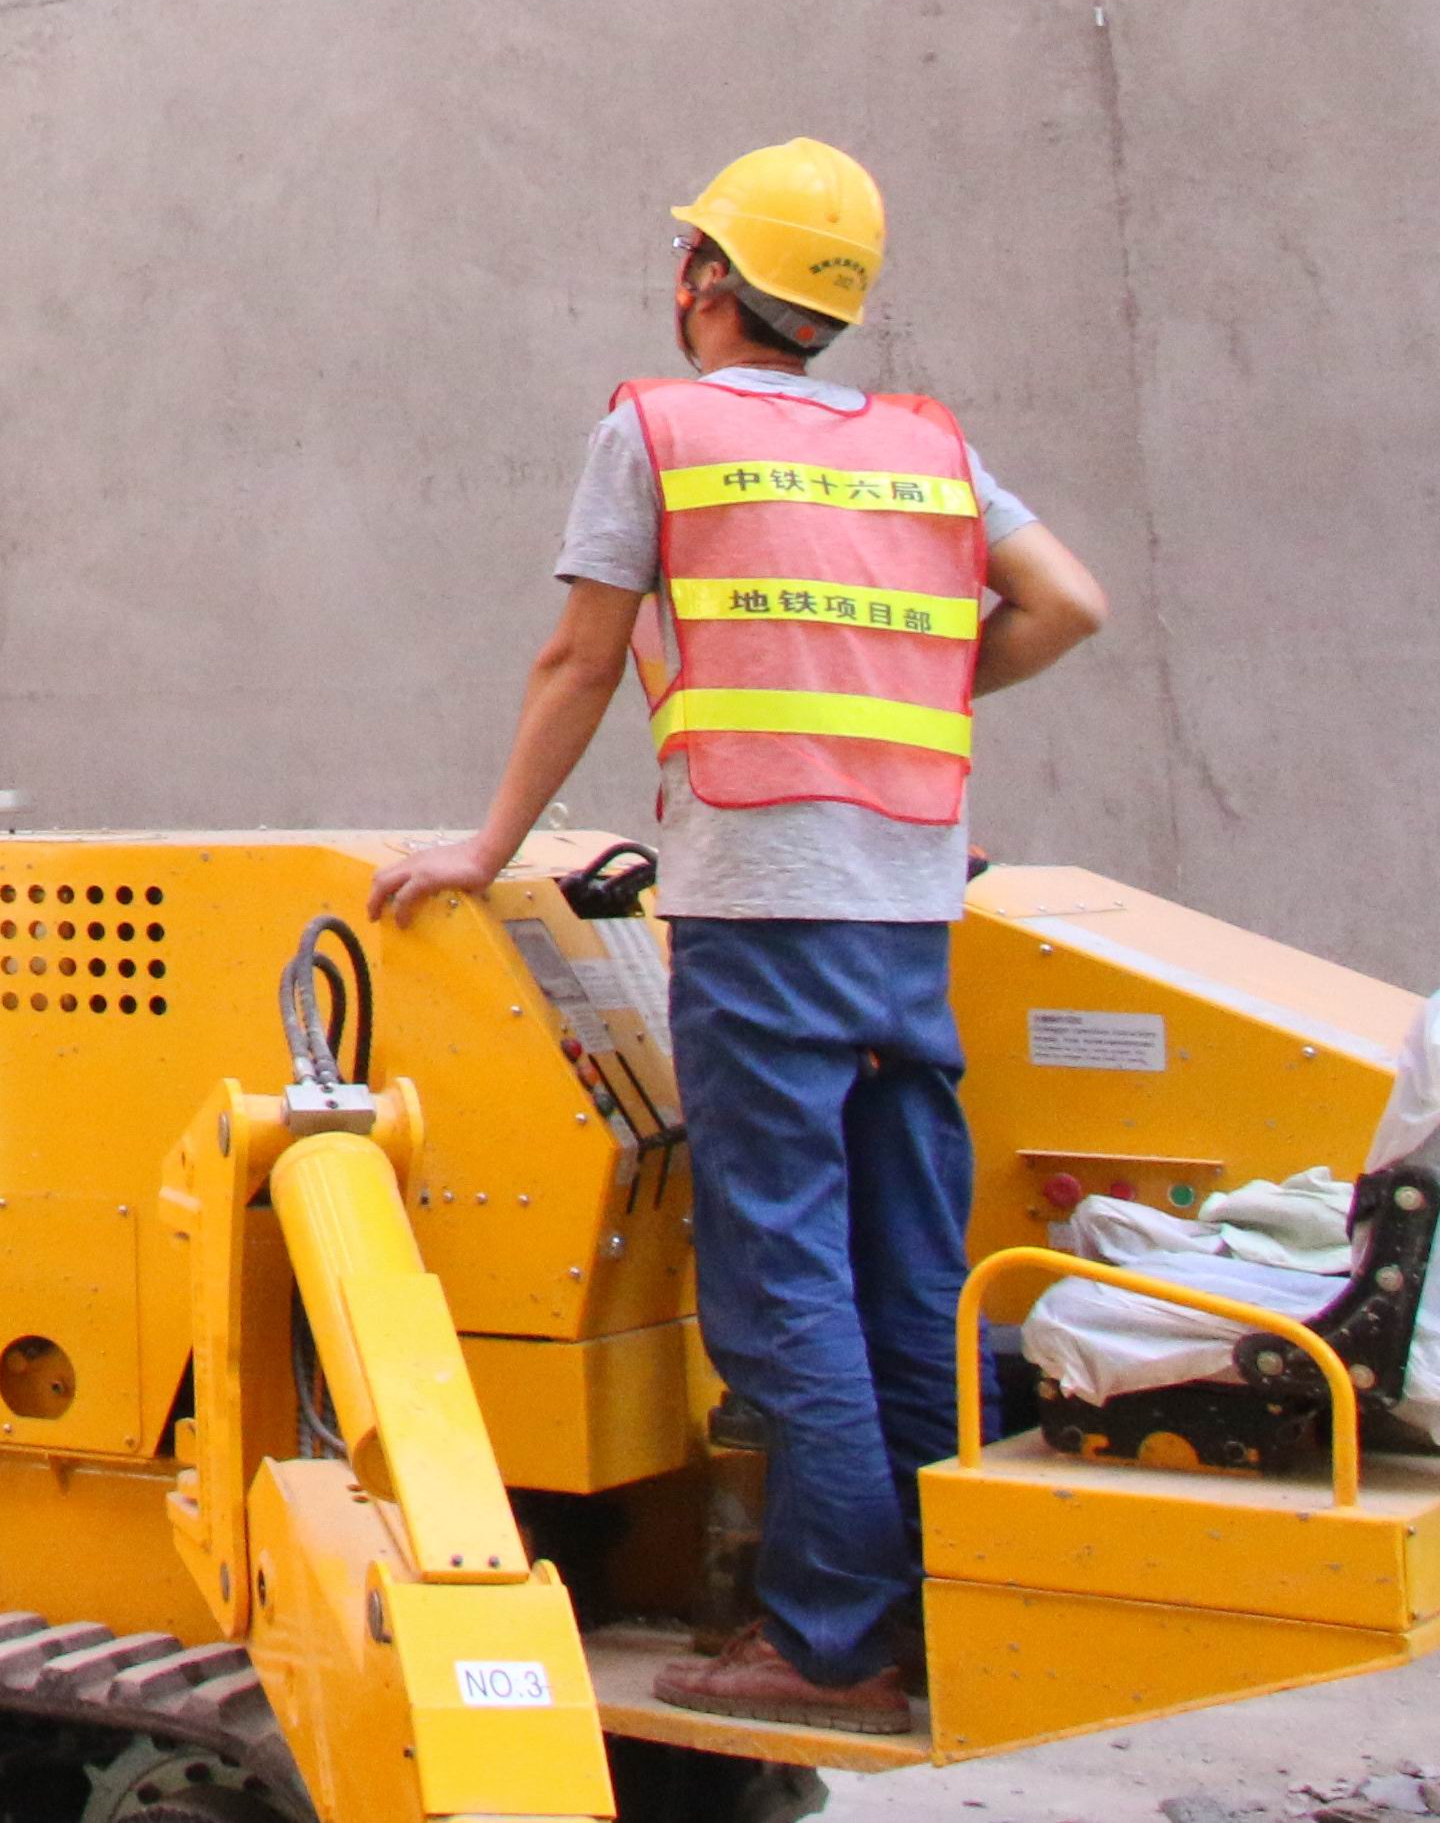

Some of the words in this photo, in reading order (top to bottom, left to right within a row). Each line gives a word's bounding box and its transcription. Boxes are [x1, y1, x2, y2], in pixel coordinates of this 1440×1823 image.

[723, 468, 925, 503] 中铁十六局
[729, 589, 932, 633] 地铁项目部
[465, 1668, 544, 1699] NO.3
